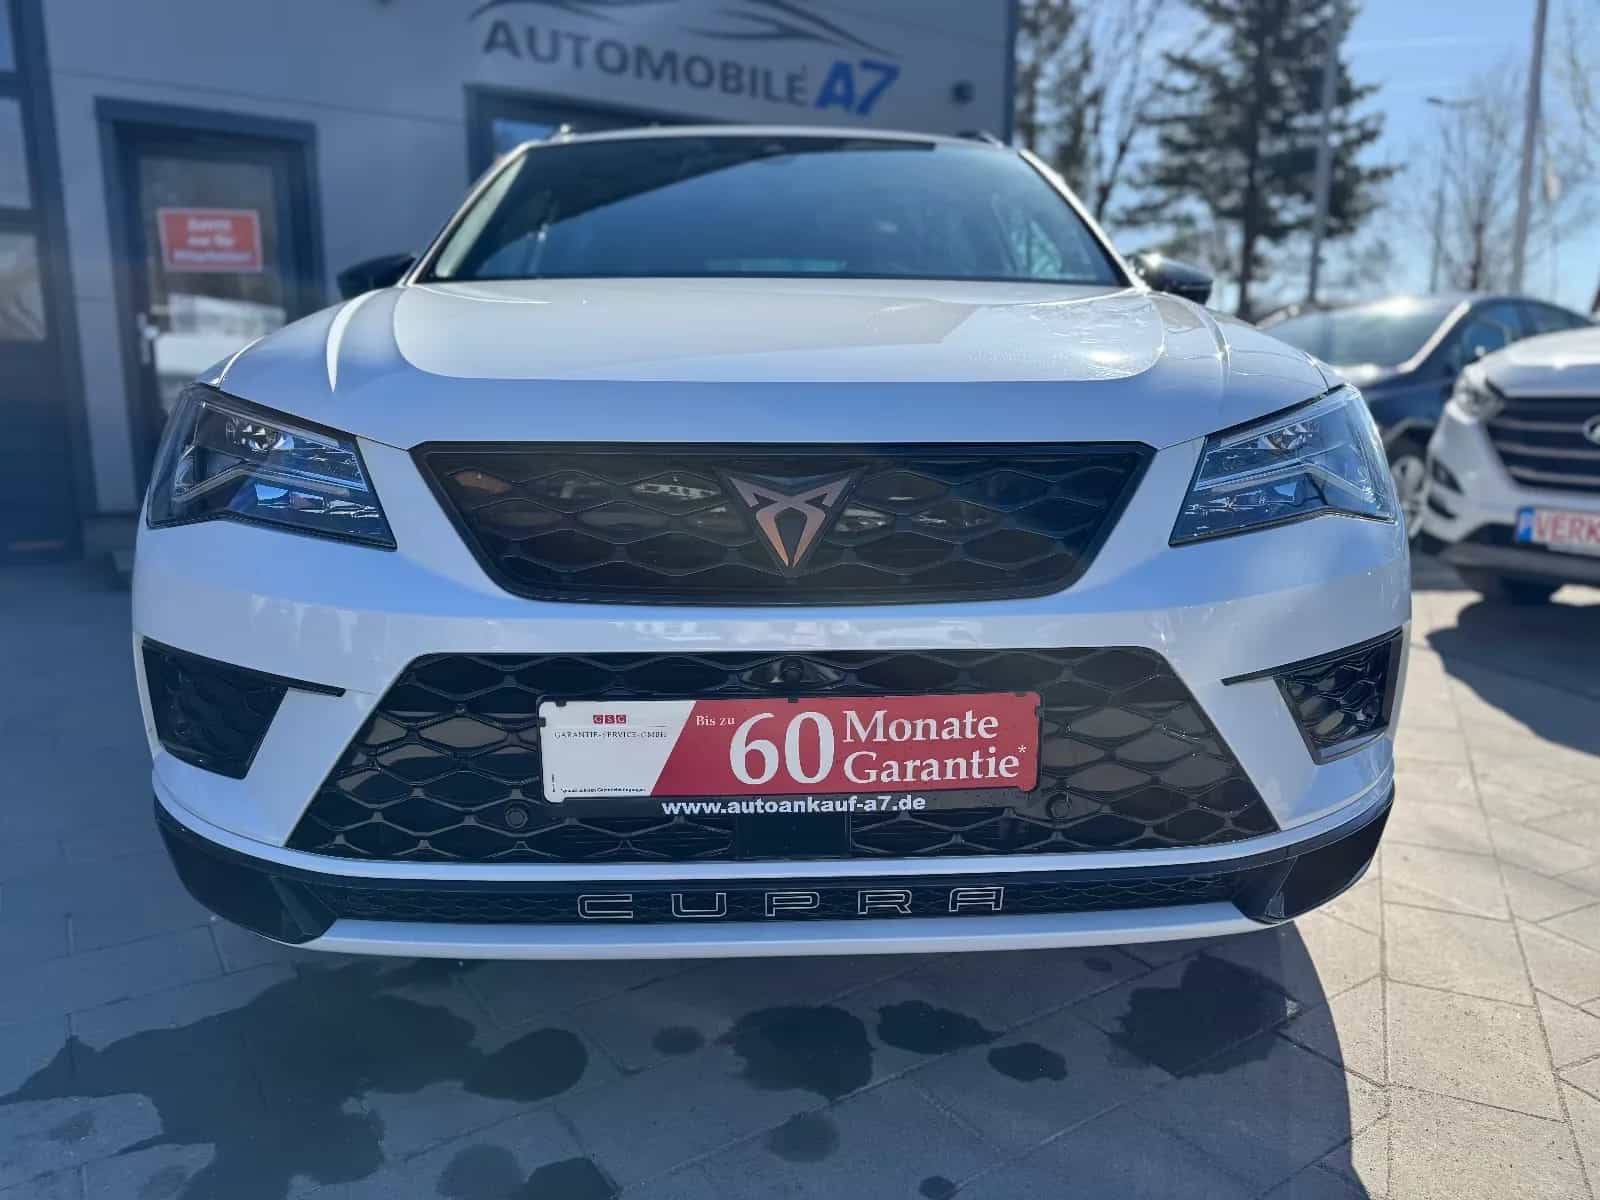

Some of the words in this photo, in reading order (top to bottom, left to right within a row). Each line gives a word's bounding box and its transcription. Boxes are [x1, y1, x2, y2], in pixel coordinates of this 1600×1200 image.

[483, 20, 808, 108] AUTOMOBILE
[814, 61, 899, 117] A7
[696, 715, 716, 727] Bis
[719, 716, 736, 726] zu
[842, 710, 999, 743] Monate
[730, 711, 835, 785] 60
[661, 794, 926, 815] www.autoankauf-a7.de
[577, 886, 1005, 919] CUPRA
